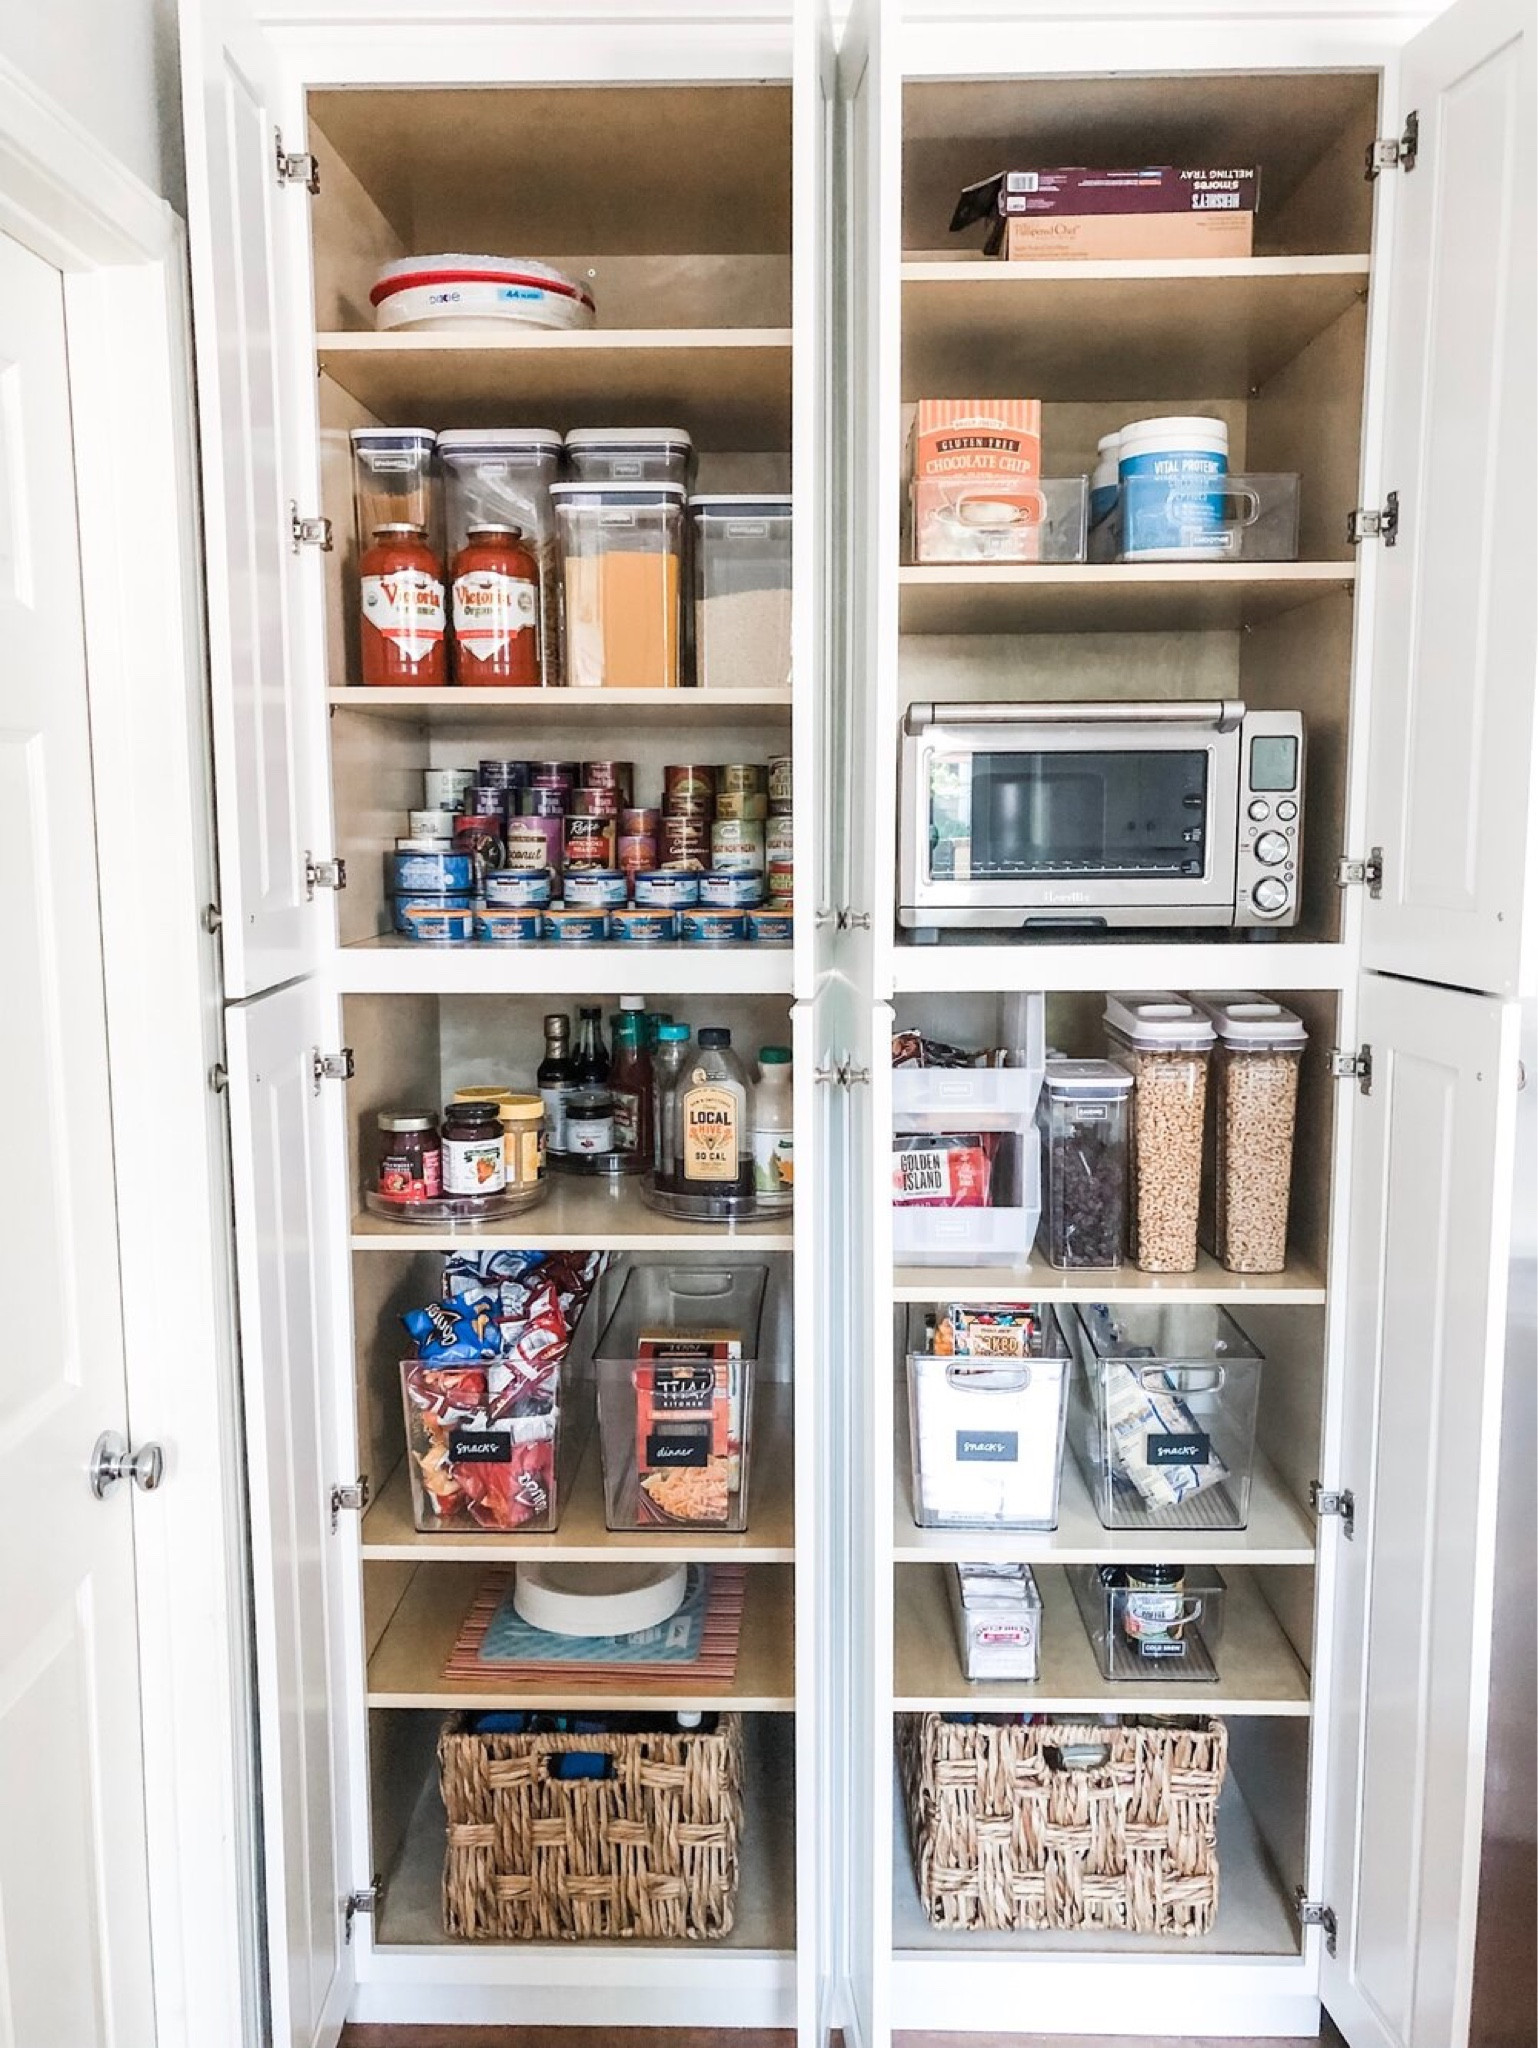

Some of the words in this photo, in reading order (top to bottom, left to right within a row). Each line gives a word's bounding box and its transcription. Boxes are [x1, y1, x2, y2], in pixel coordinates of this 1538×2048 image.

[1180, 170, 1207, 180] TRAY
[941, 437, 984, 451] GLUTEN
[988, 437, 1014, 450] FREE
[926, 454, 996, 474] CHOCOLATE
[999, 455, 1031, 473] CHIP
[1154, 460, 1180, 475] VITAL
[690, 1111, 732, 1126] LOCAL
[699, 1126, 722, 1134] HIVE
[695, 1152, 706, 1160] SO
[709, 1152, 726, 1161] CAL
[900, 1153, 941, 1173] GOLDEN
[903, 1171, 942, 1191] ISLAND
[456, 1443, 499, 1454] snacks
[656, 1446, 694, 1457] dinner
[963, 1441, 1005, 1451] snacks
[1157, 1447, 1200, 1456] snacks
